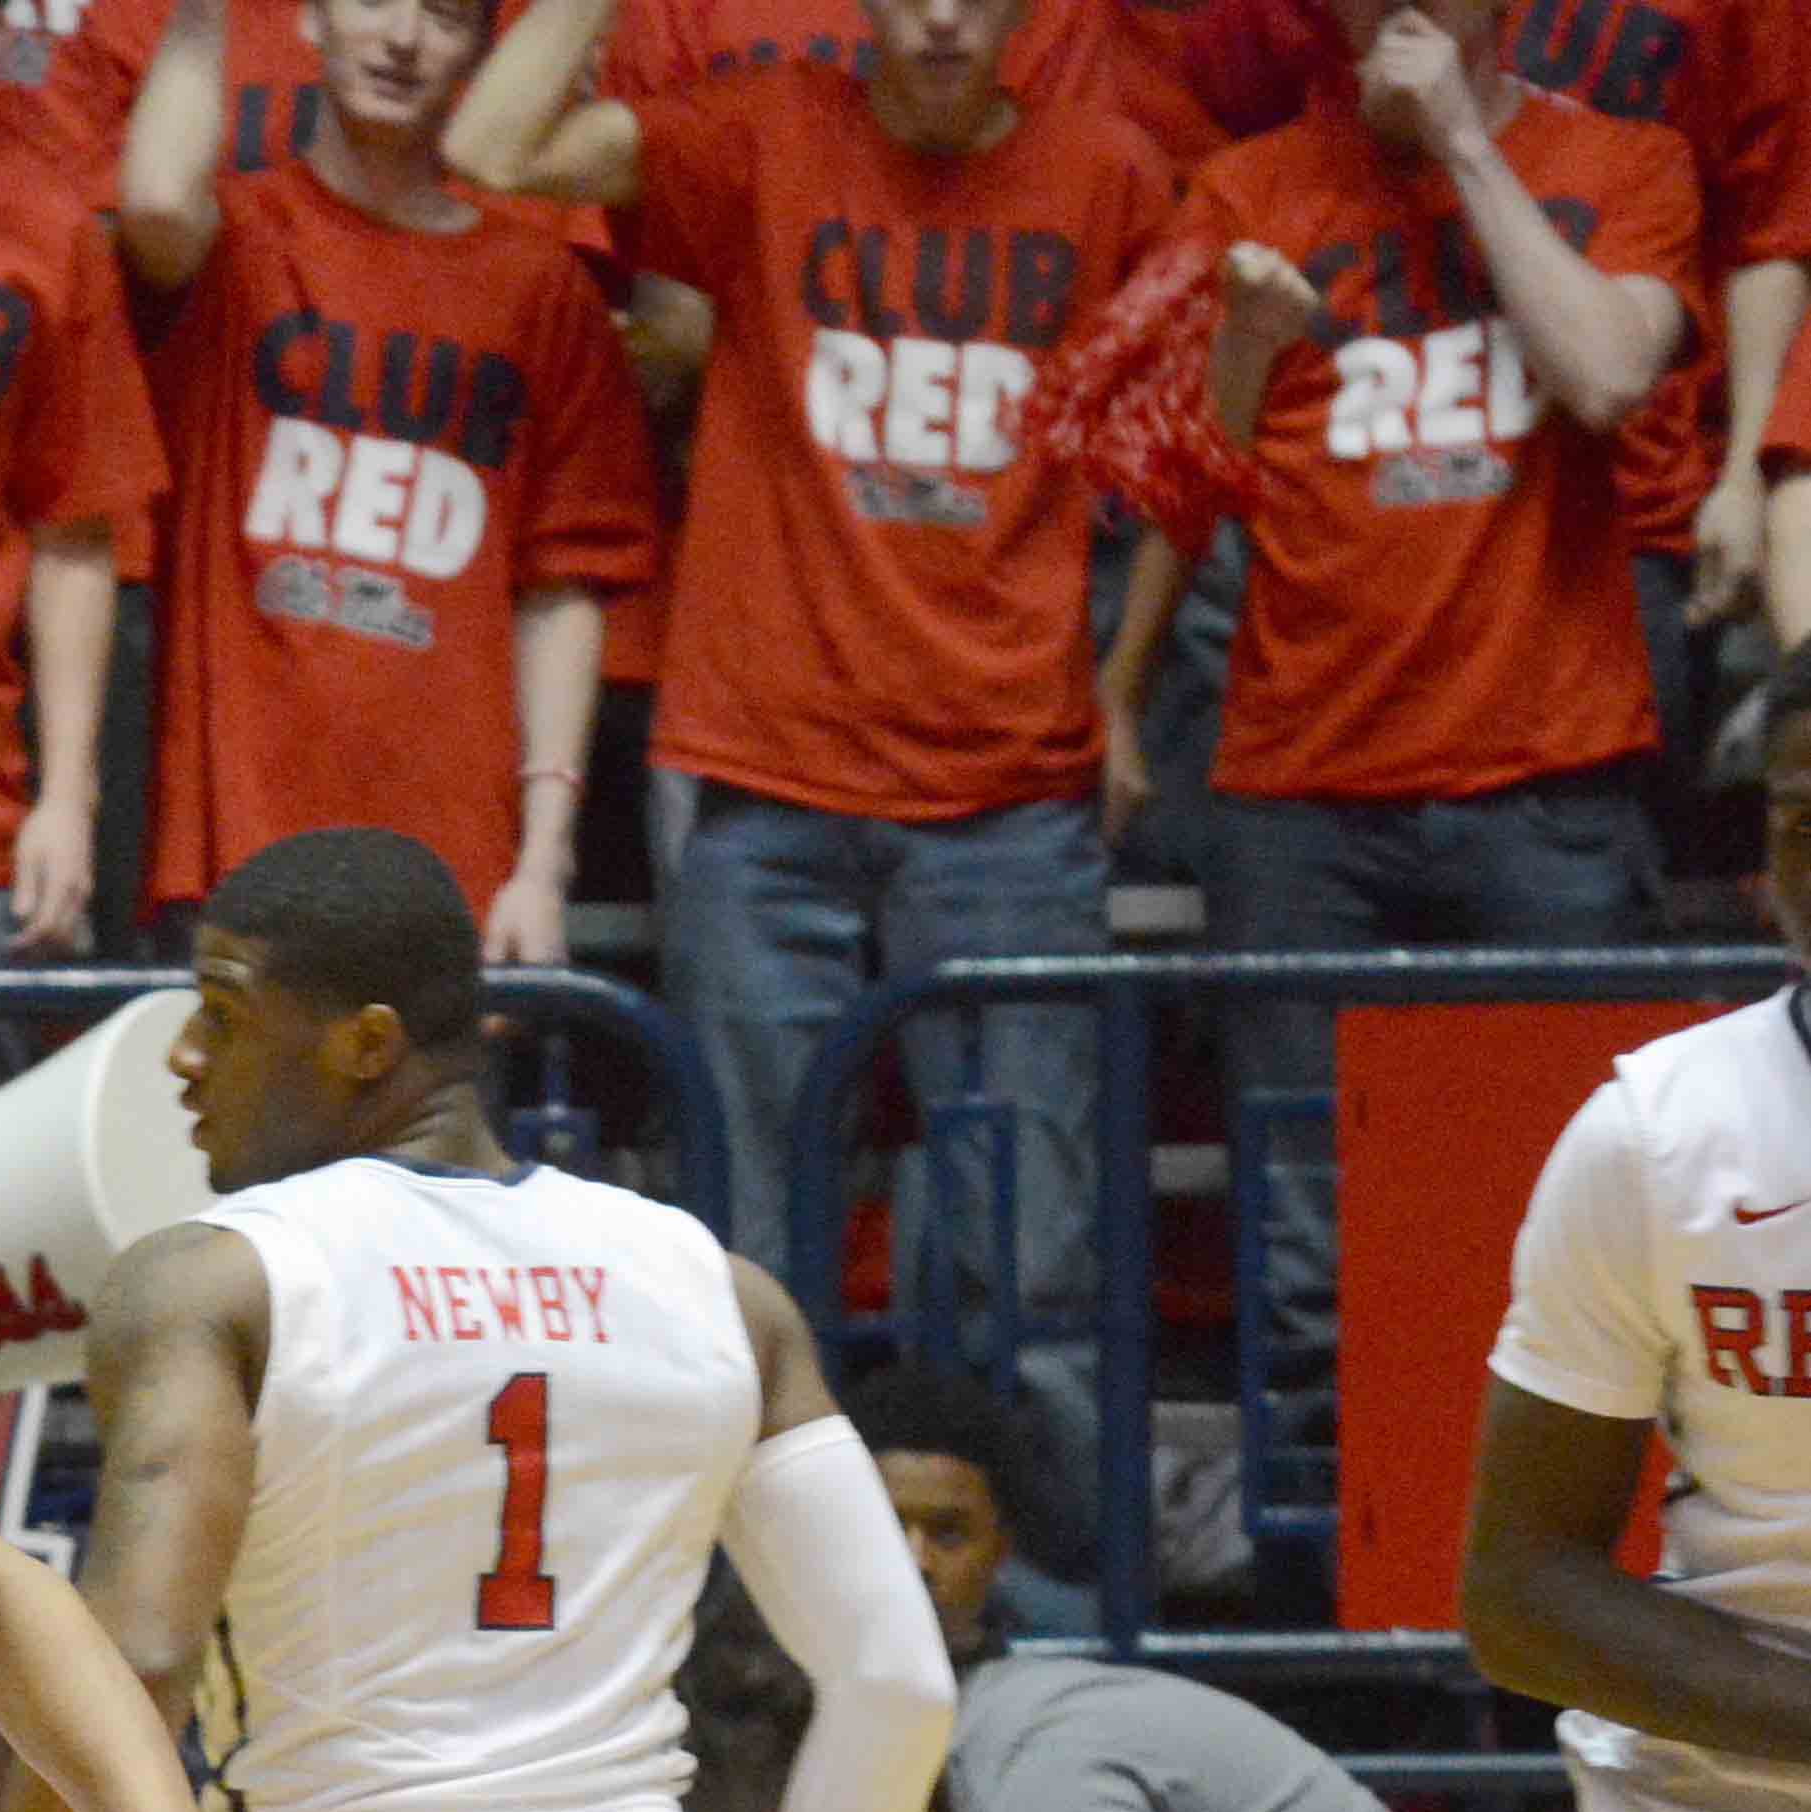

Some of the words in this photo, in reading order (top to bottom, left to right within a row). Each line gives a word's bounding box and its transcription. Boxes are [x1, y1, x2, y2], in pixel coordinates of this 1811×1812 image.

[801, 217, 1075, 349] CLUB
[252, 308, 530, 468] CLUB
[804, 328, 1037, 471] RED
[243, 416, 487, 579] RED
[389, 1265, 612, 1343] NEWBY
[474, 1371, 556, 1632] 1
